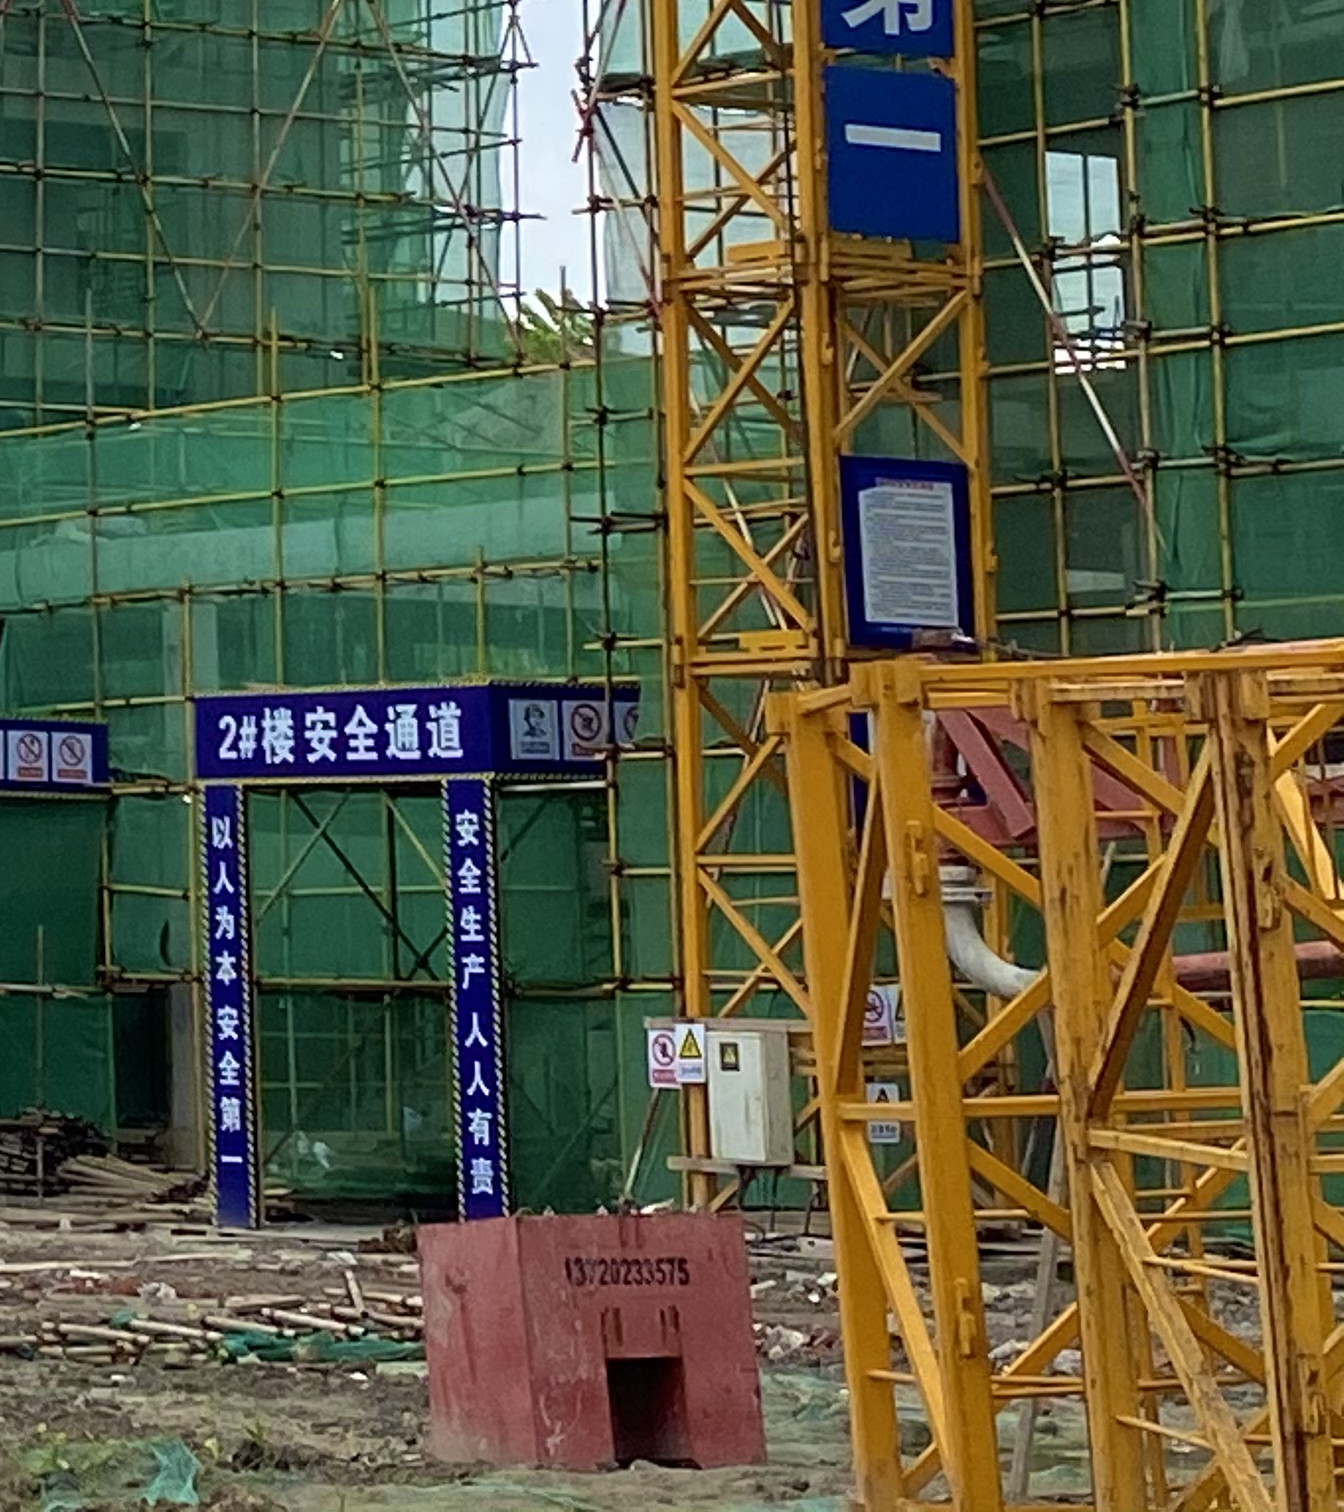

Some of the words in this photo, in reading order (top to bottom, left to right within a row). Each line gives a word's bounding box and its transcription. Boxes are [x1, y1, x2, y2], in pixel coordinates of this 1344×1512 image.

[218, 701, 464, 764] 2#楼安全通道
[212, 815, 238, 986] 以人为本
[455, 809, 486, 990] 安全生产
[217, 1005, 243, 1164] 安全第一
[464, 1012, 499, 1196] 人人有责
[565, 1257, 690, 1286] 13720233575
